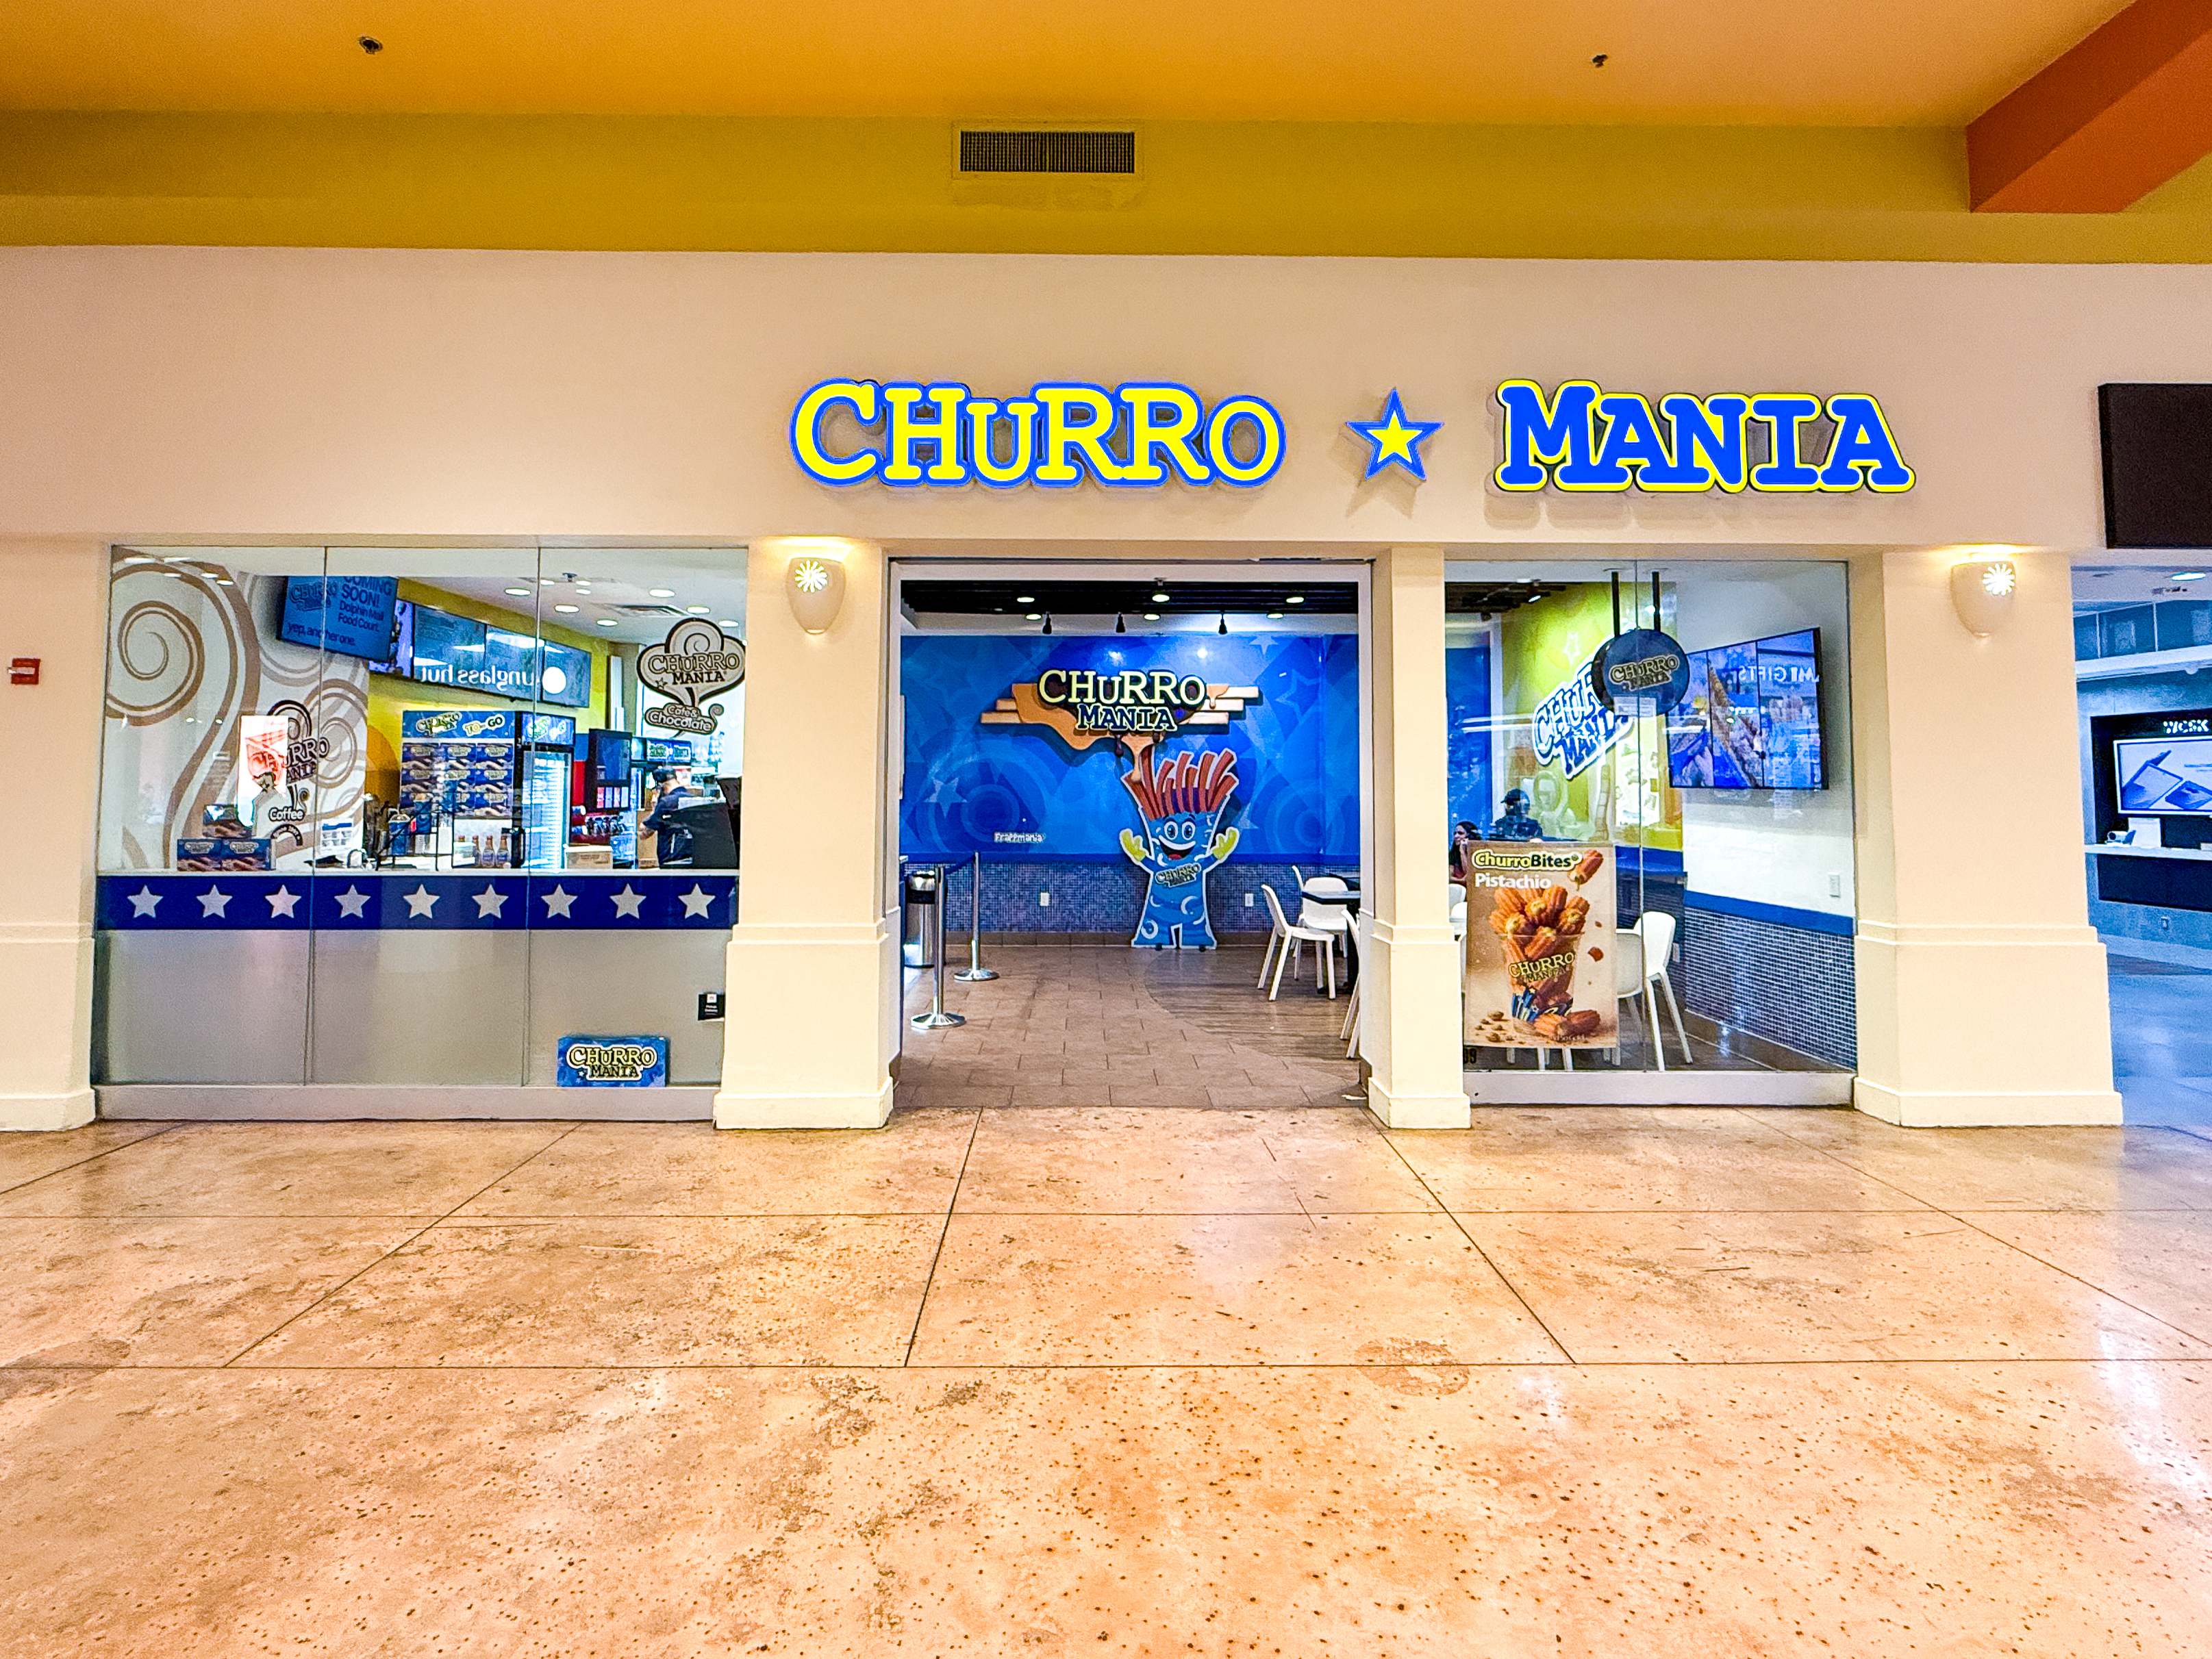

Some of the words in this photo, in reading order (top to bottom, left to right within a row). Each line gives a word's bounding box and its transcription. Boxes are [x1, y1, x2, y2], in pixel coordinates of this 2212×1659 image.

[792, 381, 1282, 483] CHURRO
[1496, 381, 1915, 492] MANIA
[342, 584, 380, 607] SOON!
[338, 613, 357, 626] Food
[340, 600, 368, 617] Dolphin
[370, 607, 385, 621] Mall
[648, 652, 740, 674] CHURRO
[1611, 656, 1679, 683] CHURRO
[672, 671, 725, 685] MANIA
[1039, 670, 1205, 705] CHURRO
[1075, 703, 1178, 731] MANIA
[1534, 661, 1603, 759] CHUR
[650, 711, 712, 731] Chocolate
[270, 807, 304, 820] Coffee
[1475, 872, 1552, 889] Pistachio
[1509, 952, 1574, 978] CHURRO
[570, 1047, 655, 1067] CHURRO
[590, 1064, 639, 1078] MANIA
